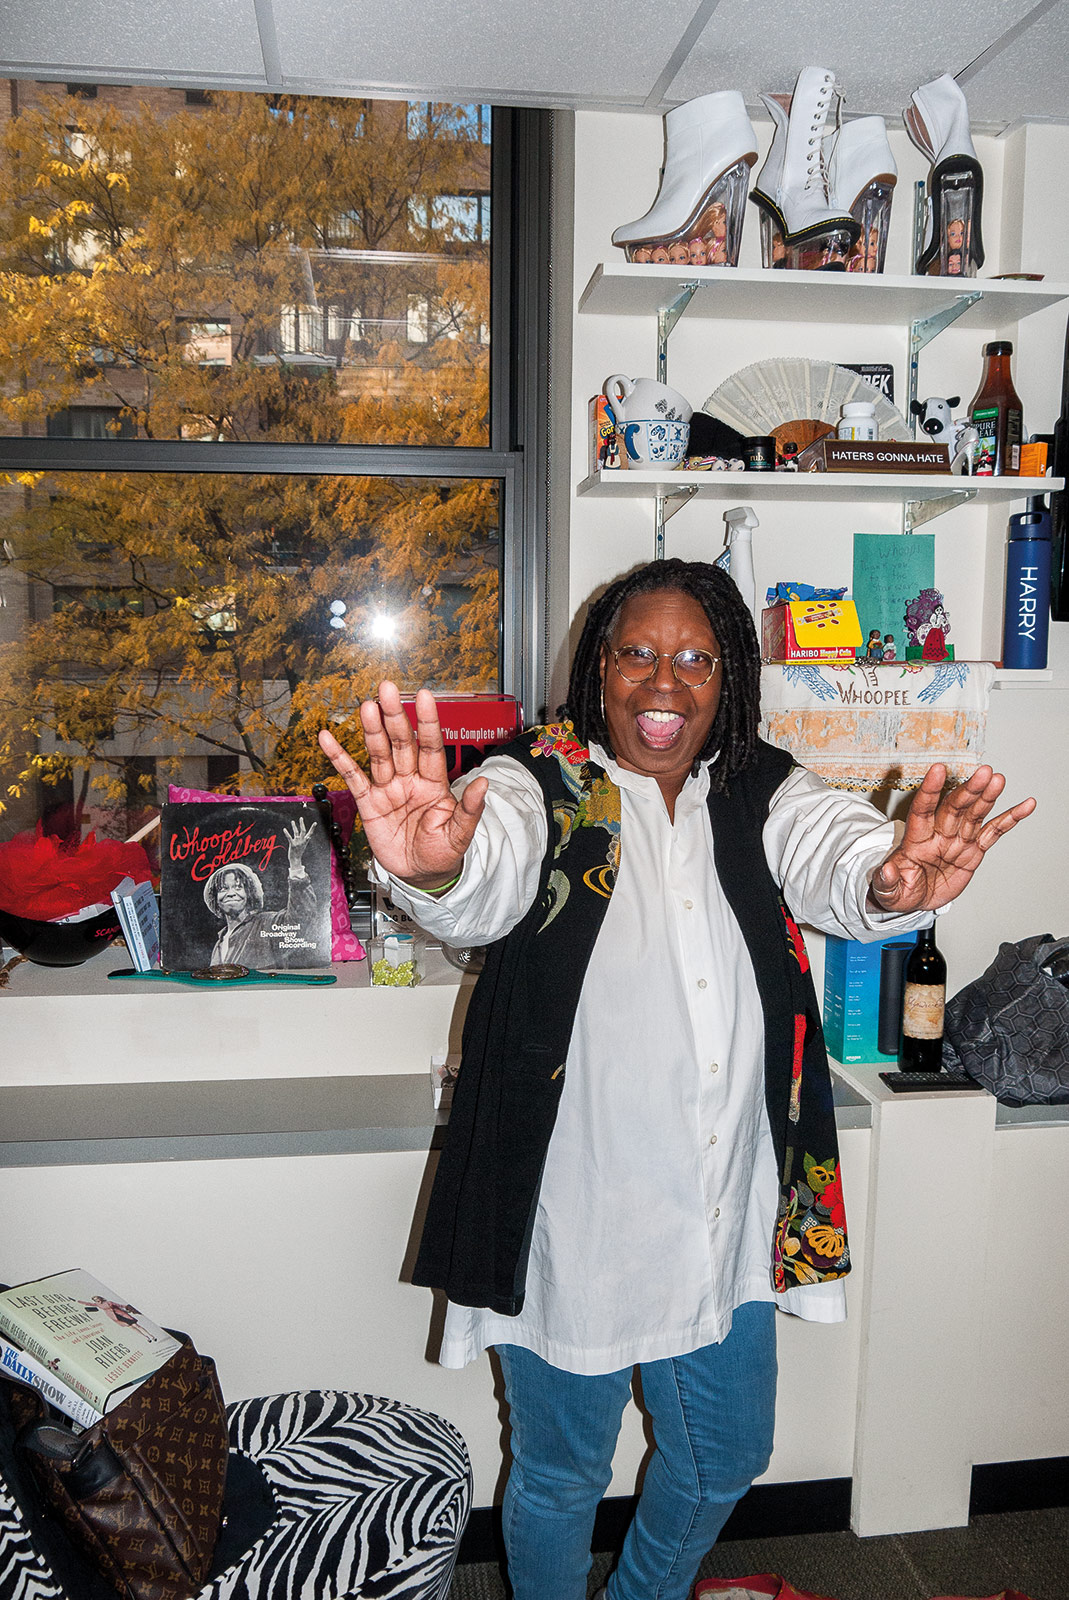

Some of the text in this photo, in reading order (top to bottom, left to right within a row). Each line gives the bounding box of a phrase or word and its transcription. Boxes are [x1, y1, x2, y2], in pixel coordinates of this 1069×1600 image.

[600, 426, 614, 437] Gor
[979, 429, 994, 437] EAF
[832, 451, 944, 463] HATERS GONNA HATE
[1018, 567, 1039, 641] HARRY
[790, 649, 819, 658] HARIBO
[839, 648, 852, 656] Cola
[836, 681, 911, 706] WHOOPEE
[460, 727, 495, 742] Complete
[169, 821, 256, 860] Whoopi
[191, 834, 287, 882] Goldberg
[260, 930, 298, 939] Broadway
[271, 923, 301, 932] Original
[279, 941, 317, 950] Recording
[284, 936, 305, 944] Show
[7, 1293, 71, 1309] LAST GIRL
[32, 1303, 79, 1320] BEFORE
[43, 1312, 94, 1333] FREEWAY
[85, 1334, 114, 1354] JOAN
[5, 1346, 19, 1359] THE
[95, 1343, 131, 1370] RIVERS
[104, 1365, 126, 1384] LESLIE
